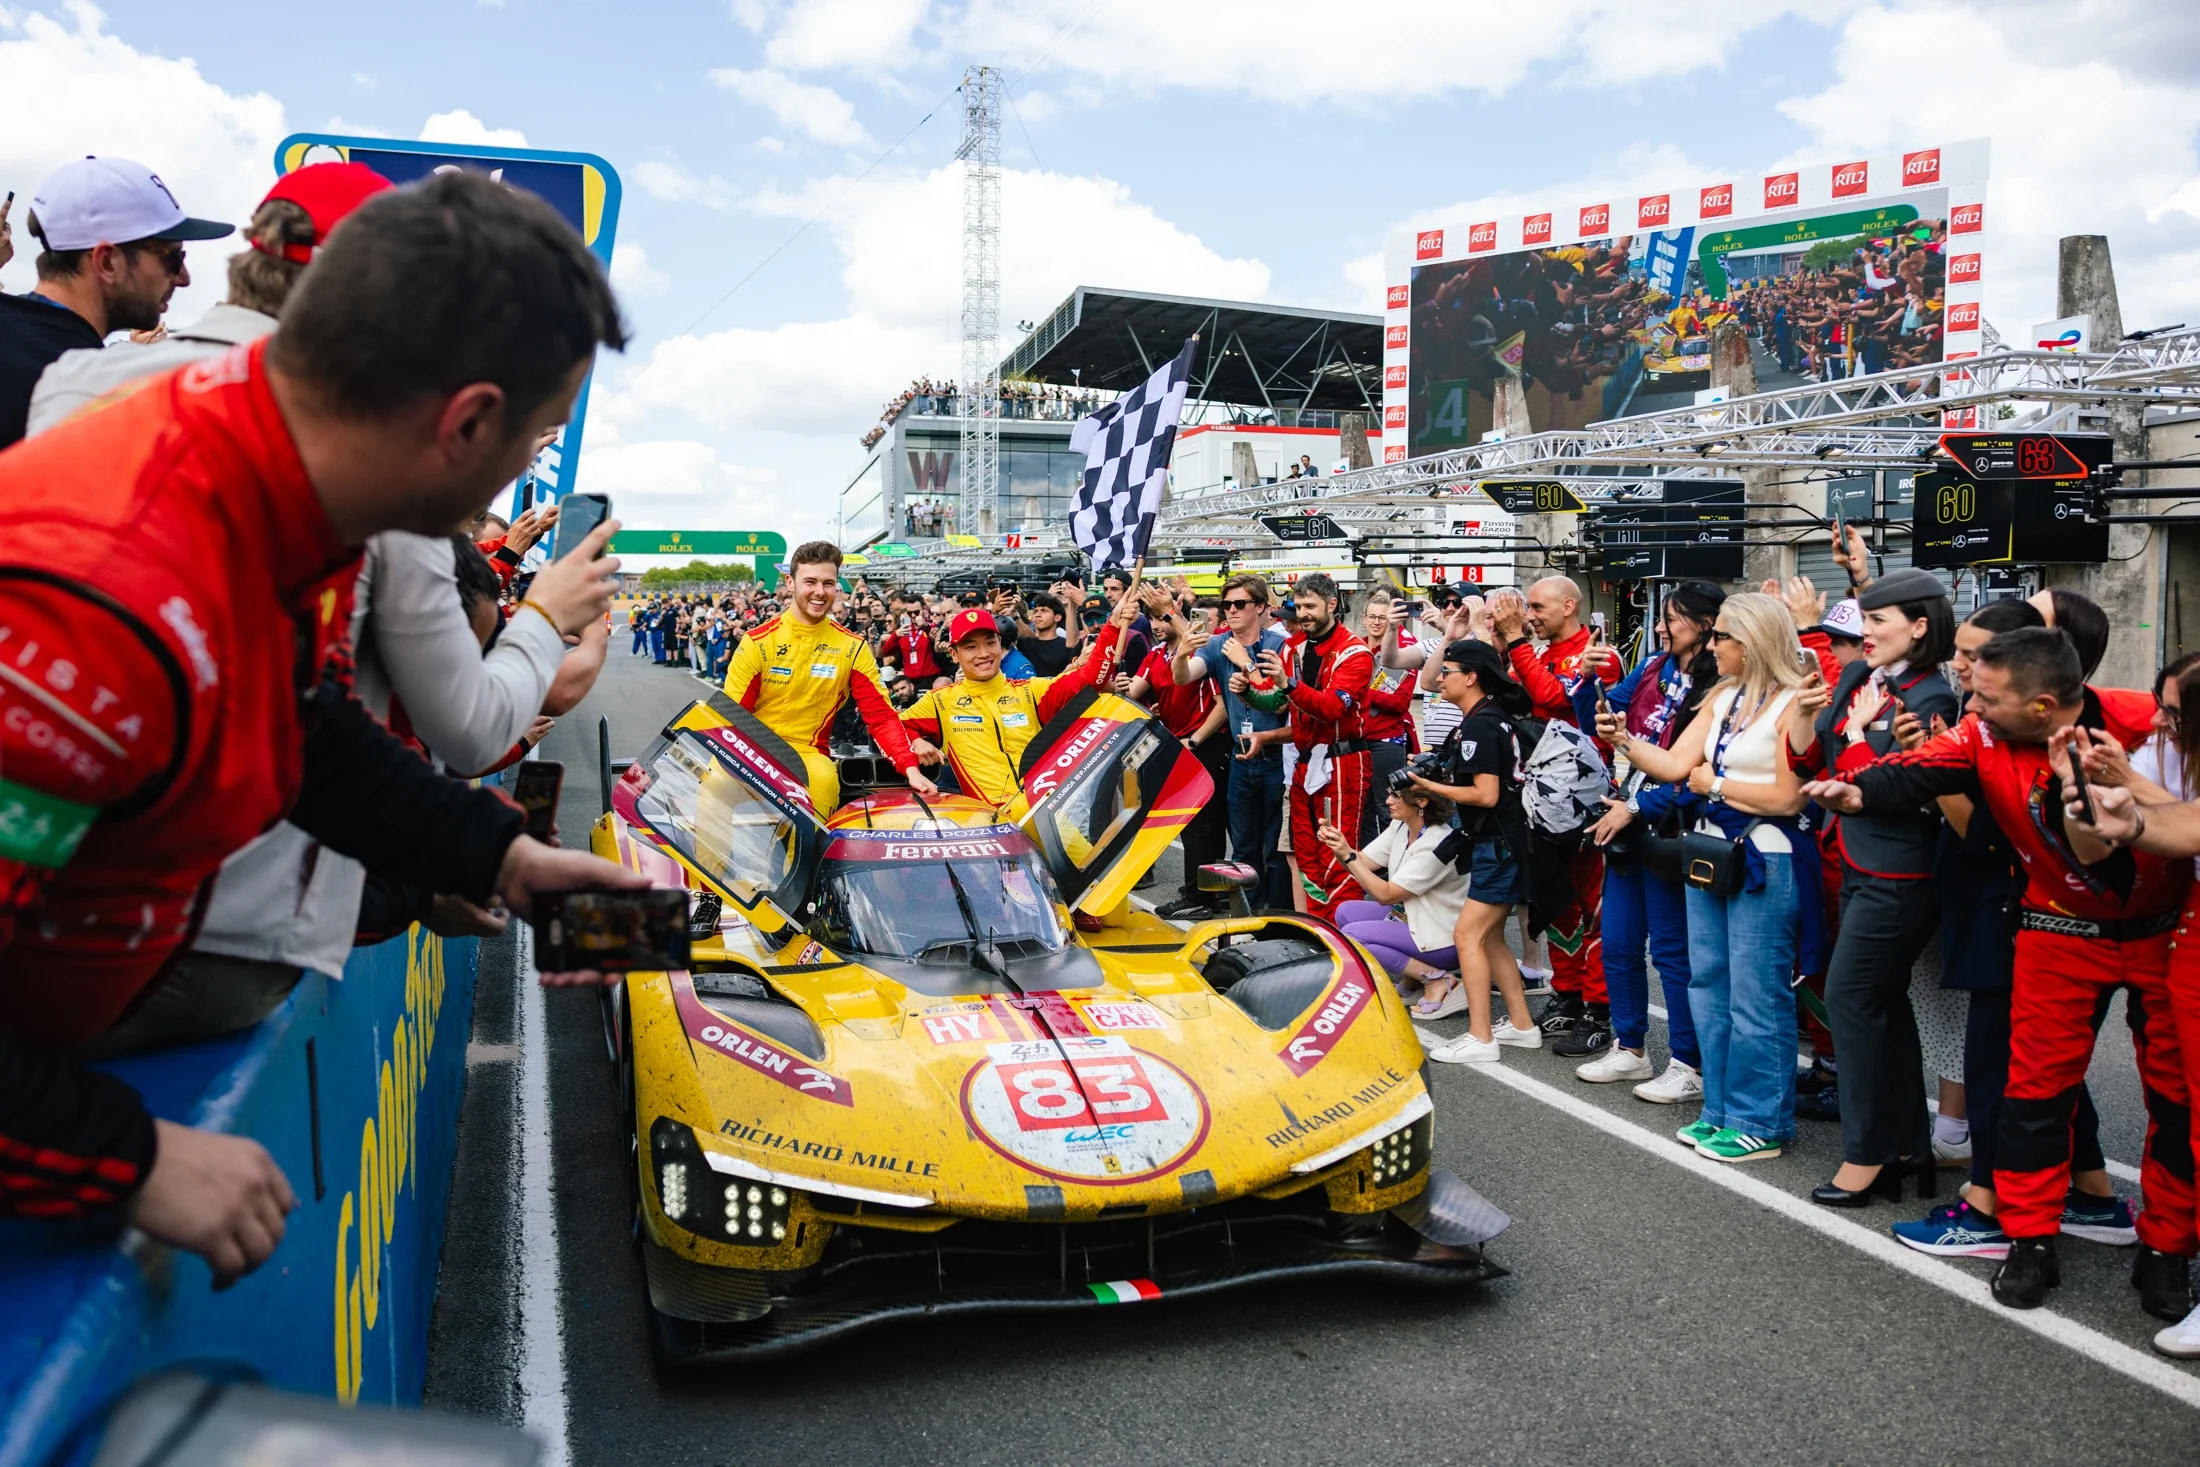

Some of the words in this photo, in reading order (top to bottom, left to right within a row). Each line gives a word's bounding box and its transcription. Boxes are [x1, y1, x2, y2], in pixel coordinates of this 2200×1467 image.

[1906, 158, 1938, 176] RTL2
[1835, 170, 1866, 187] RTL2
[1767, 181, 1797, 198] RTL2
[1703, 191, 1730, 208] RTL2
[1641, 202, 1669, 219] RTL2
[1953, 211, 1980, 225] RTL2
[1581, 212, 1608, 228] RTL2
[1862, 218, 1899, 231] ROLEX
[1471, 229, 1496, 246] RTL2
[1525, 221, 1551, 237] RTL2
[1784, 230, 1818, 243] ROLEX
[1419, 237, 1443, 253] RTL2
[1711, 241, 1744, 253] ROLEX
[1951, 260, 1979, 275] RTL2
[1389, 291, 1408, 302] RTL2
[1949, 310, 1977, 324] RTL2
[1388, 331, 1407, 342] RTL2
[1387, 371, 1406, 382] RTL2
[1387, 411, 1405, 422] RTL2
[1385, 452, 1405, 463] RTL2
[2018, 438, 2055, 474] 63
[906, 451, 955, 491] W
[1536, 484, 1563, 510] 60
[1937, 484, 1976, 524] 60
[1308, 518, 1330, 538] 61
[658, 544, 693, 553] ROLEX
[735, 545, 770, 553] ROLEX
[1010, 536, 1018, 548] 7
[1468, 567, 1478, 582] 8
[846, 641, 858, 659] Sabelt
[1057, 718, 1108, 768] ORLEN
[718, 748, 740, 769] KUBICA
[721, 729, 781, 780] ORLEN
[1084, 750, 1105, 771] HANSON
[752, 777, 778, 799] HANSON
[1057, 780, 1076, 801] KUBICA
[848, 829, 937, 839] CHARLES
[942, 827, 993, 839] POZZI
[880, 839, 1010, 860] Ferrari
[1088, 1004, 1150, 1015] HYPER
[1313, 982, 1366, 1035] ORLEN
[924, 1013, 983, 1044] HY
[1093, 1013, 1163, 1027] CAR
[700, 1025, 791, 1074] ORLEN
[1012, 1063, 1152, 1120] 83
[1265, 1101, 1354, 1149] RICHARD
[1352, 1067, 1405, 1107] MILLE
[1064, 1125, 1135, 1143] WEC
[719, 1118, 845, 1162] RICHARD
[851, 1151, 940, 1179] MILLE
